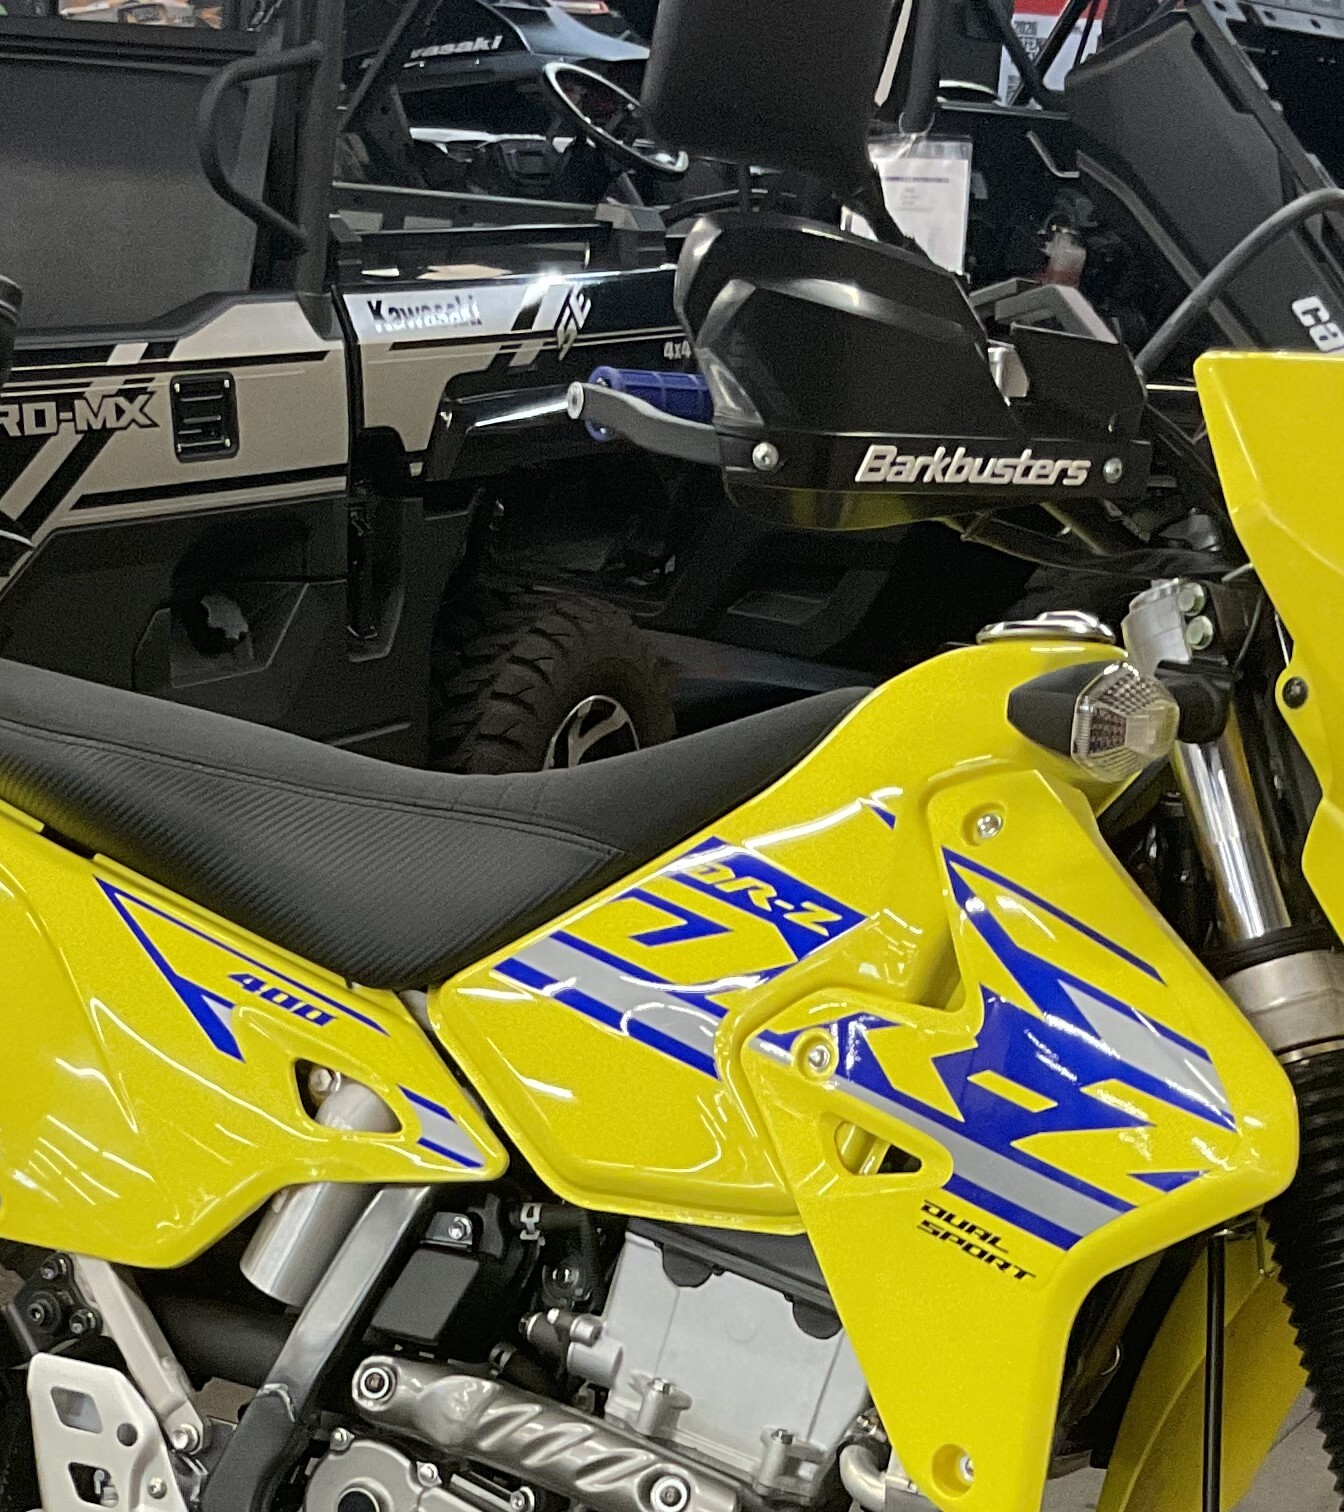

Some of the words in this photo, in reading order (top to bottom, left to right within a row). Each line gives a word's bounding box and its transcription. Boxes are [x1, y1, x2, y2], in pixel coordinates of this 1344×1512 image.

[367, 294, 478, 333] Kawasaki
[663, 340, 692, 360] 4x4
[854, 444, 1092, 487] Barkbusters
[684, 862, 843, 937] DR-Z
[228, 974, 338, 1026] 400
[916, 1219, 1036, 1279] SPORT
[921, 1199, 1008, 1253] DUAL
